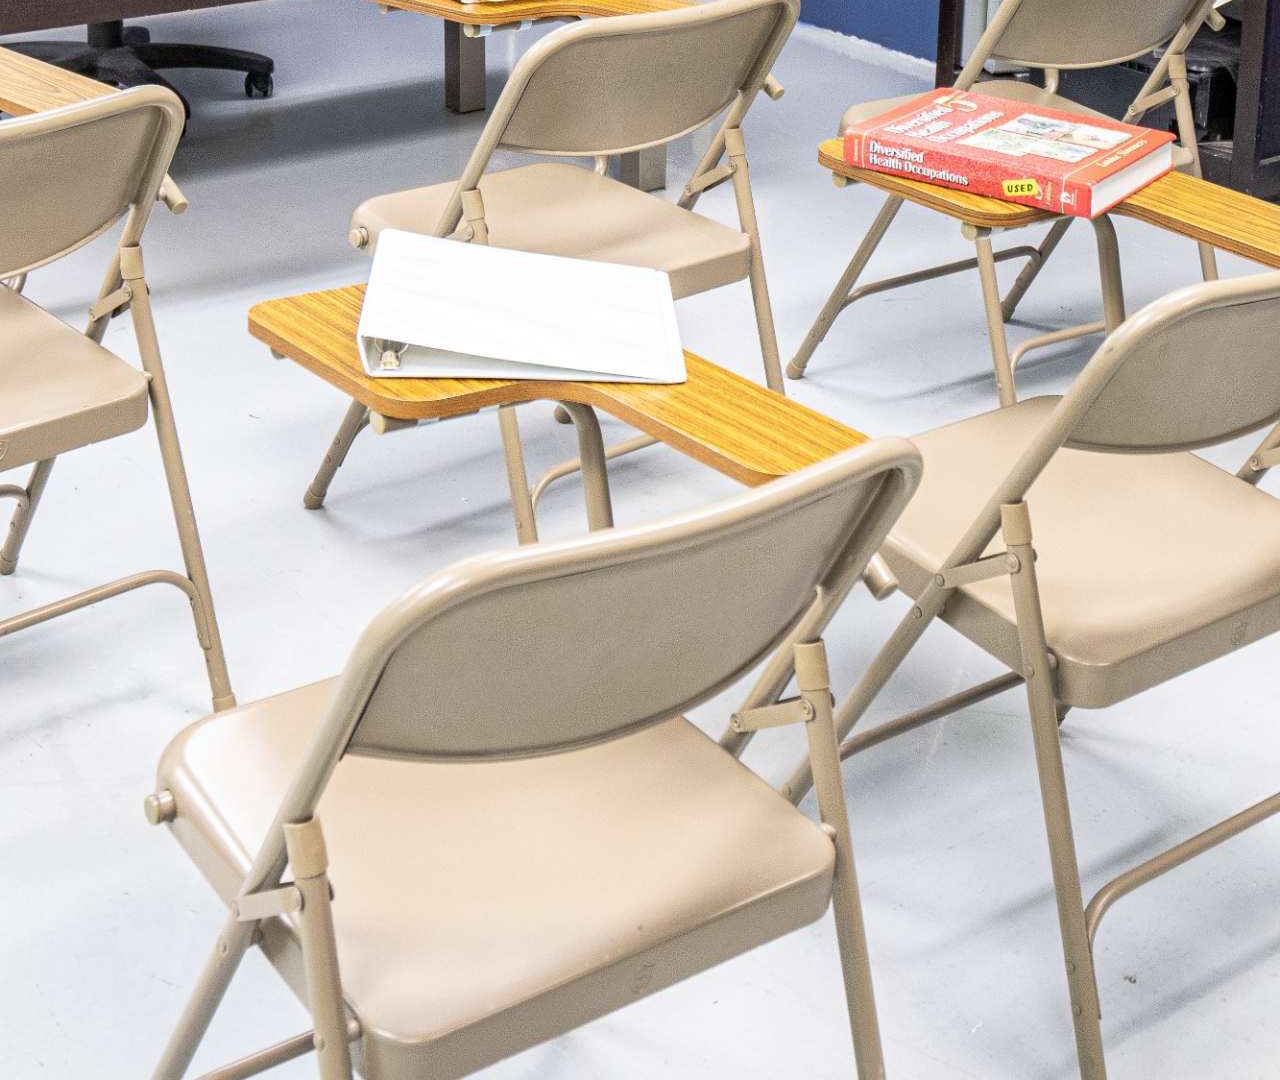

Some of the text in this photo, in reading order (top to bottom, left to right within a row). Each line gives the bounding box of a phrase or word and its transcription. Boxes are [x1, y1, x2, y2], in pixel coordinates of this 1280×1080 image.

[870, 140, 926, 163] Diversified
[870, 153, 968, 186] Health Occupations
[1007, 183, 1033, 193] USED
